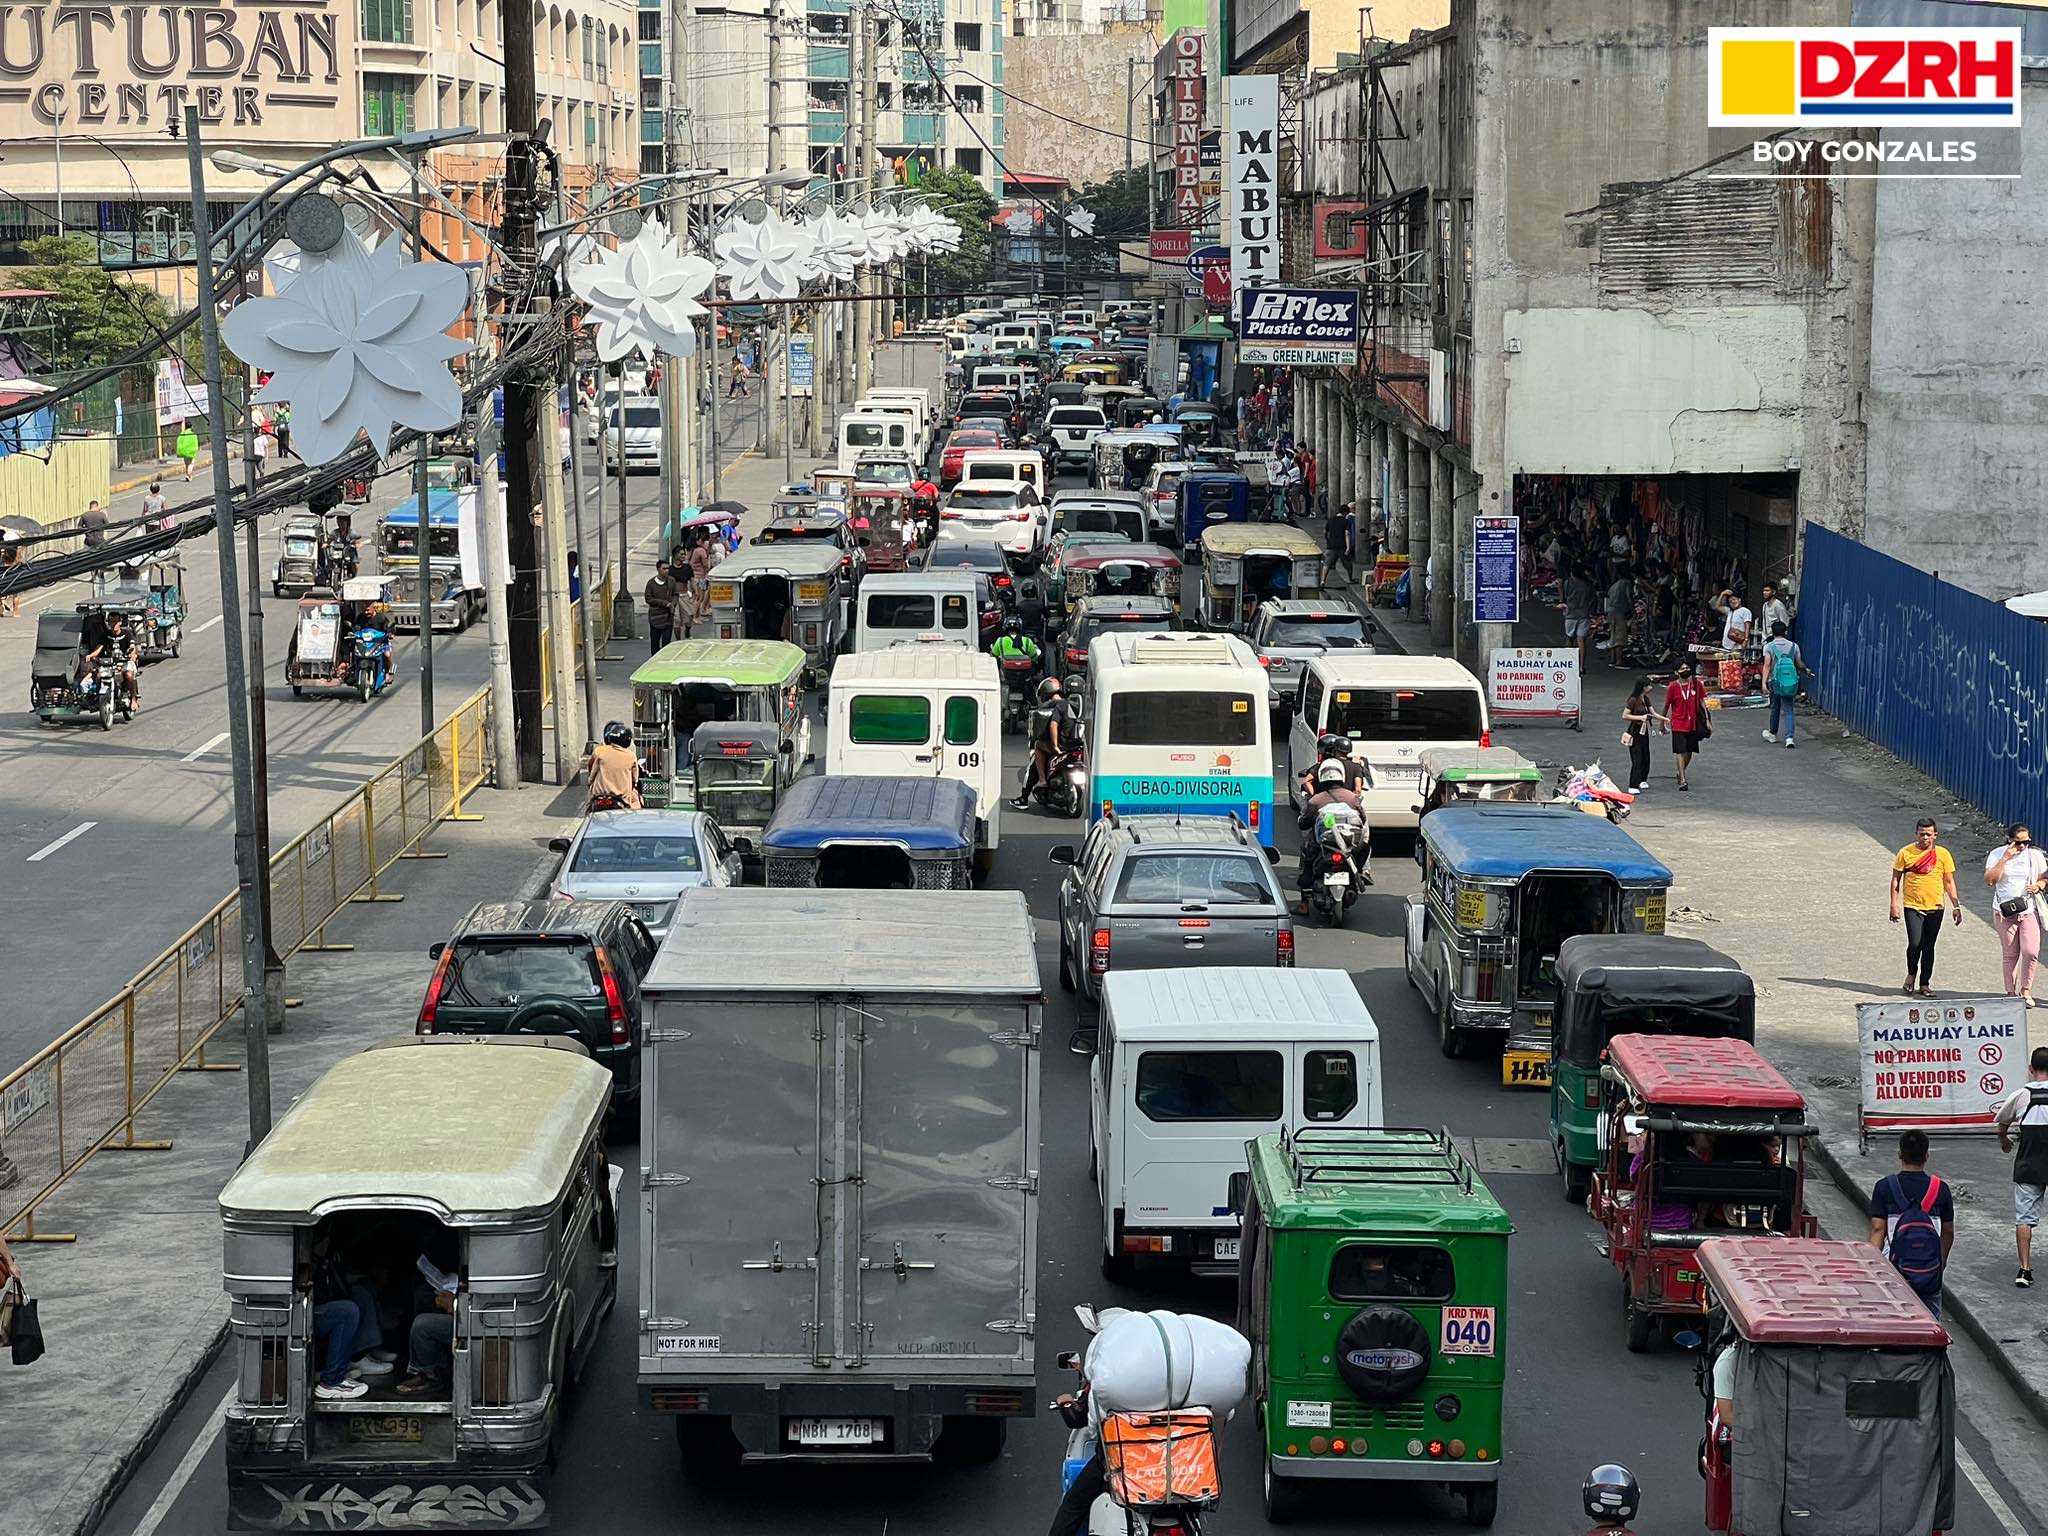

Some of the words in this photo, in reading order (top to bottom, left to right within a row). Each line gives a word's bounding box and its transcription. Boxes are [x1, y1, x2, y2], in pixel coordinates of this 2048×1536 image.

[33, 83, 263, 123] CENTER
[1234, 97, 1253, 106] LIFE
[1152, 239, 1189, 250] SORELLA
[1247, 321, 1302, 336] Plastic
[1305, 323, 1353, 337] Cover
[1273, 349, 1303, 362] GREEN
[1305, 351, 1340, 363] PLANET
[1496, 660, 1545, 668] MABUHAY
[1547, 660, 1573, 668] LANE
[1496, 672, 1508, 680] NO
[1509, 672, 1544, 681] PARKING
[1509, 685, 1546, 693] VENDORS
[958, 752, 979, 767] 09
[1121, 780, 1243, 796] CUBAO-DIVISORIA
[1873, 1026, 1963, 1042] MABUHAY
[1968, 1024, 2015, 1038] LANE
[1874, 1050, 1895, 1064] NO
[1896, 1048, 1962, 1063] PARKING
[1875, 1072, 1895, 1085] NO
[1898, 1070, 1966, 1084] VENDORS
[1876, 1085, 1943, 1099] ALLOWED
[1216, 1242, 1237, 1254] CAE
[1448, 1308, 1467, 1318] KRD
[1469, 1308, 1489, 1319] TWA
[1446, 1319, 1490, 1345] 040
[658, 1338, 674, 1349] NOT
[677, 1338, 696, 1349] FOR
[698, 1338, 719, 1349] HIRE
[802, 1422, 828, 1439] NBH
[836, 1423, 870, 1439] 1708
